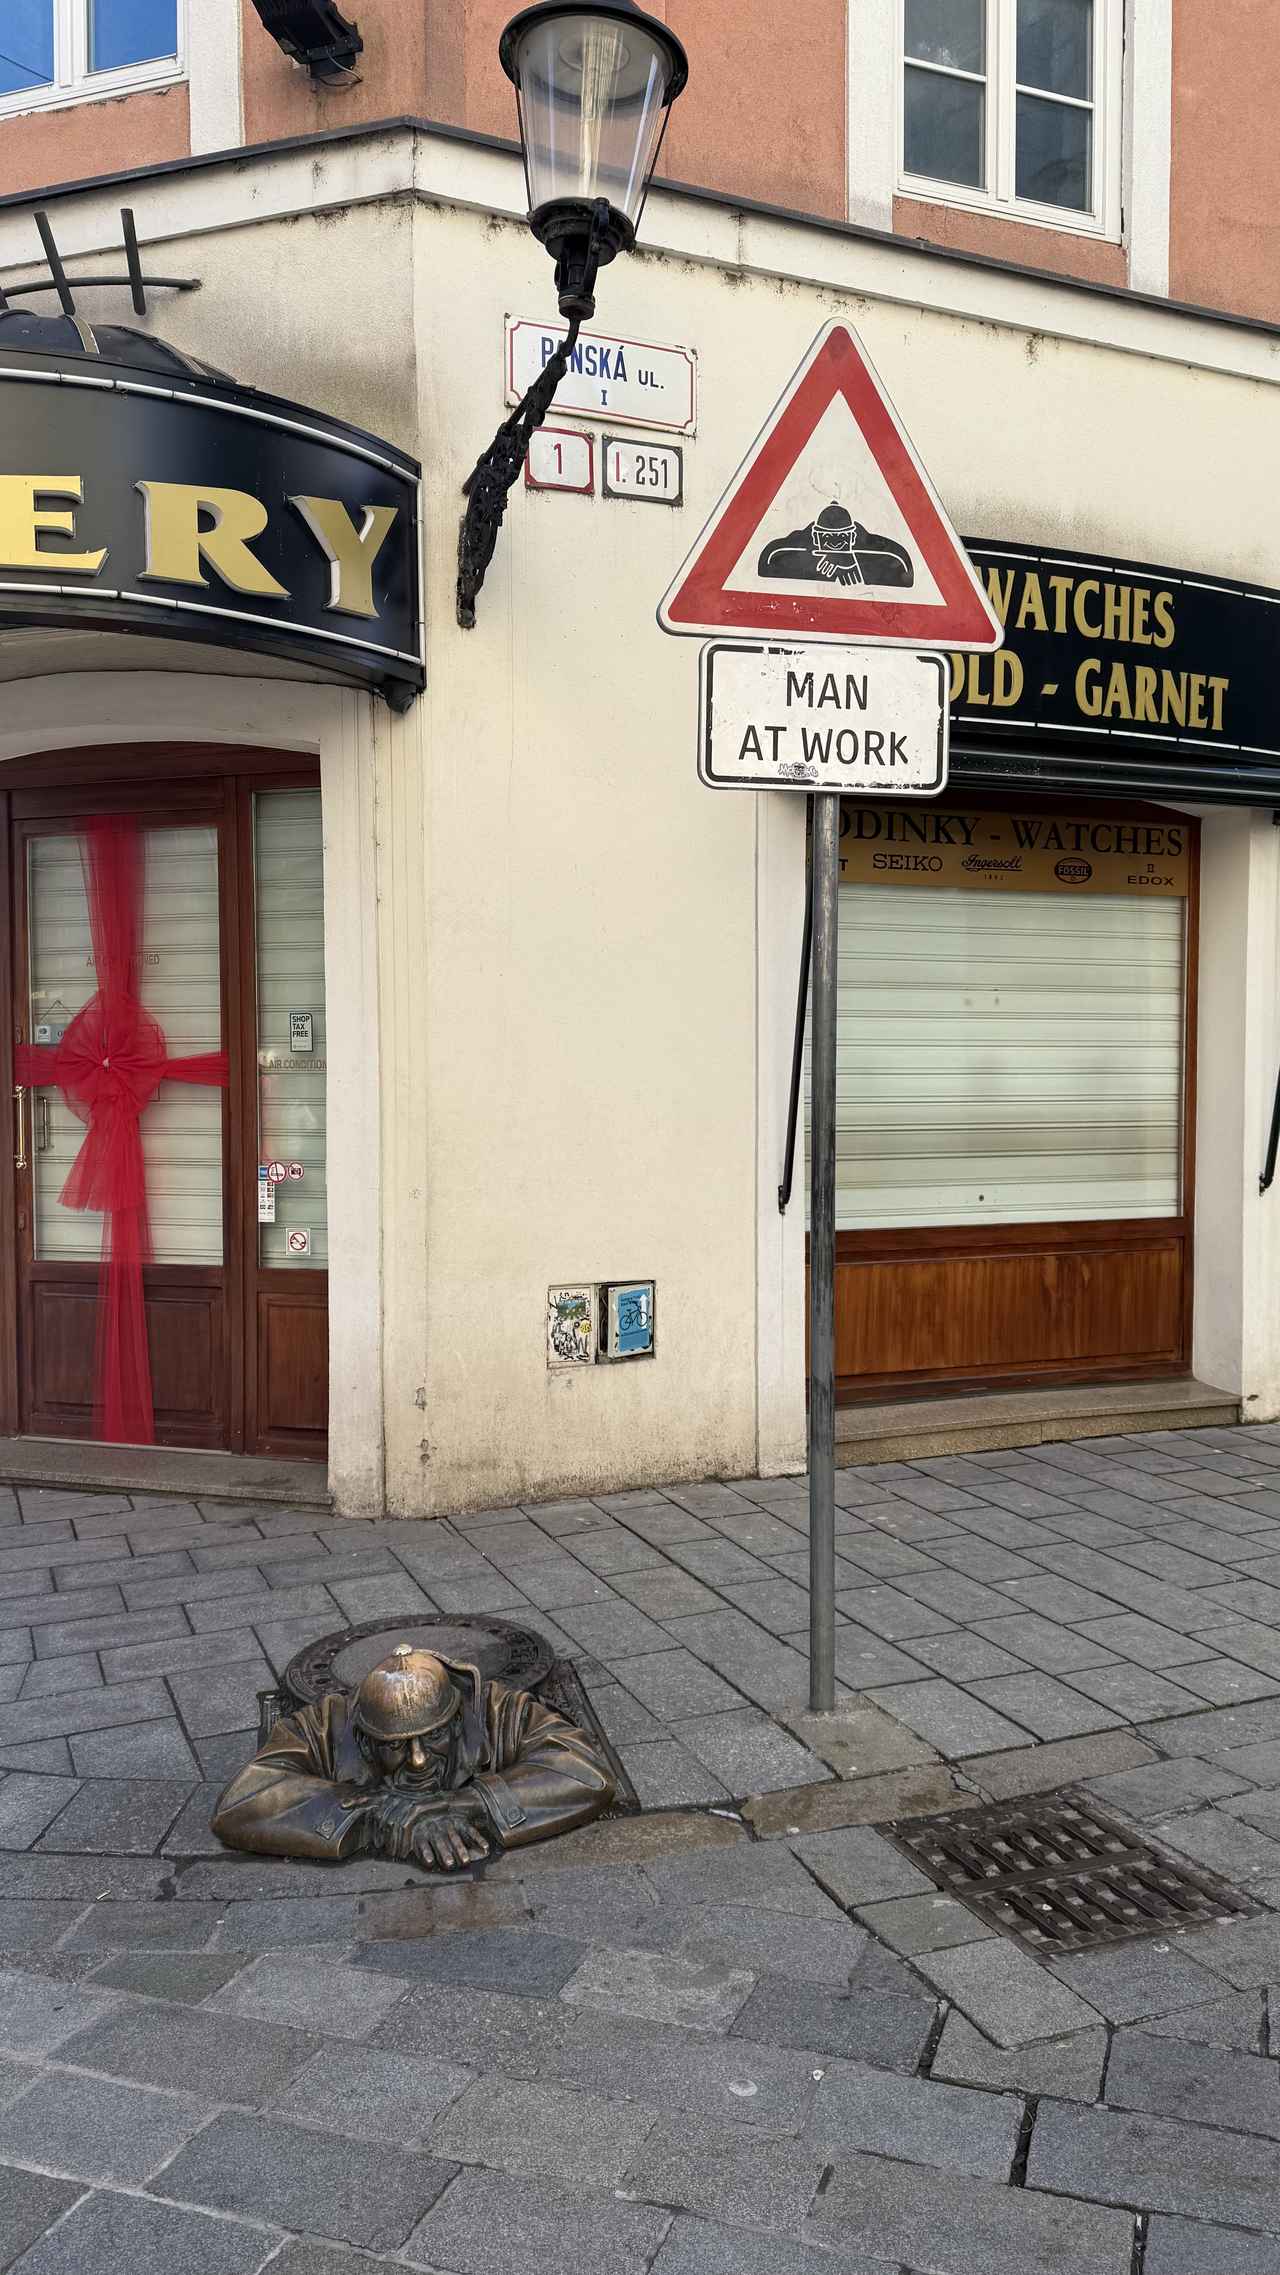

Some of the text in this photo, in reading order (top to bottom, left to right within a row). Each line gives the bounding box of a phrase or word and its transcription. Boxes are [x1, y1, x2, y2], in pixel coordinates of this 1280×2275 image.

[541, 336, 665, 389] PNSKÁ UL.
[553, 442, 563, 475] 1
[635, 455, 668, 488] 251
[974, 565, 1175, 649] WATCHES
[786, 670, 868, 710] MAN
[1074, 657, 1230, 731] GARNET
[738, 724, 909, 767] AT WORK
[1010, 818, 1183, 858] WATCHES
[872, 852, 944, 873] SEIKO
[960, 854, 1025, 873] Ingersoll
[1057, 864, 1090, 876] FOSSIL
[1127, 875, 1176, 887] EDOX
[292, 1015, 310, 1023] SHOP
[292, 1030, 309, 1038] FREE
[269, 1059, 282, 1069] AIR
